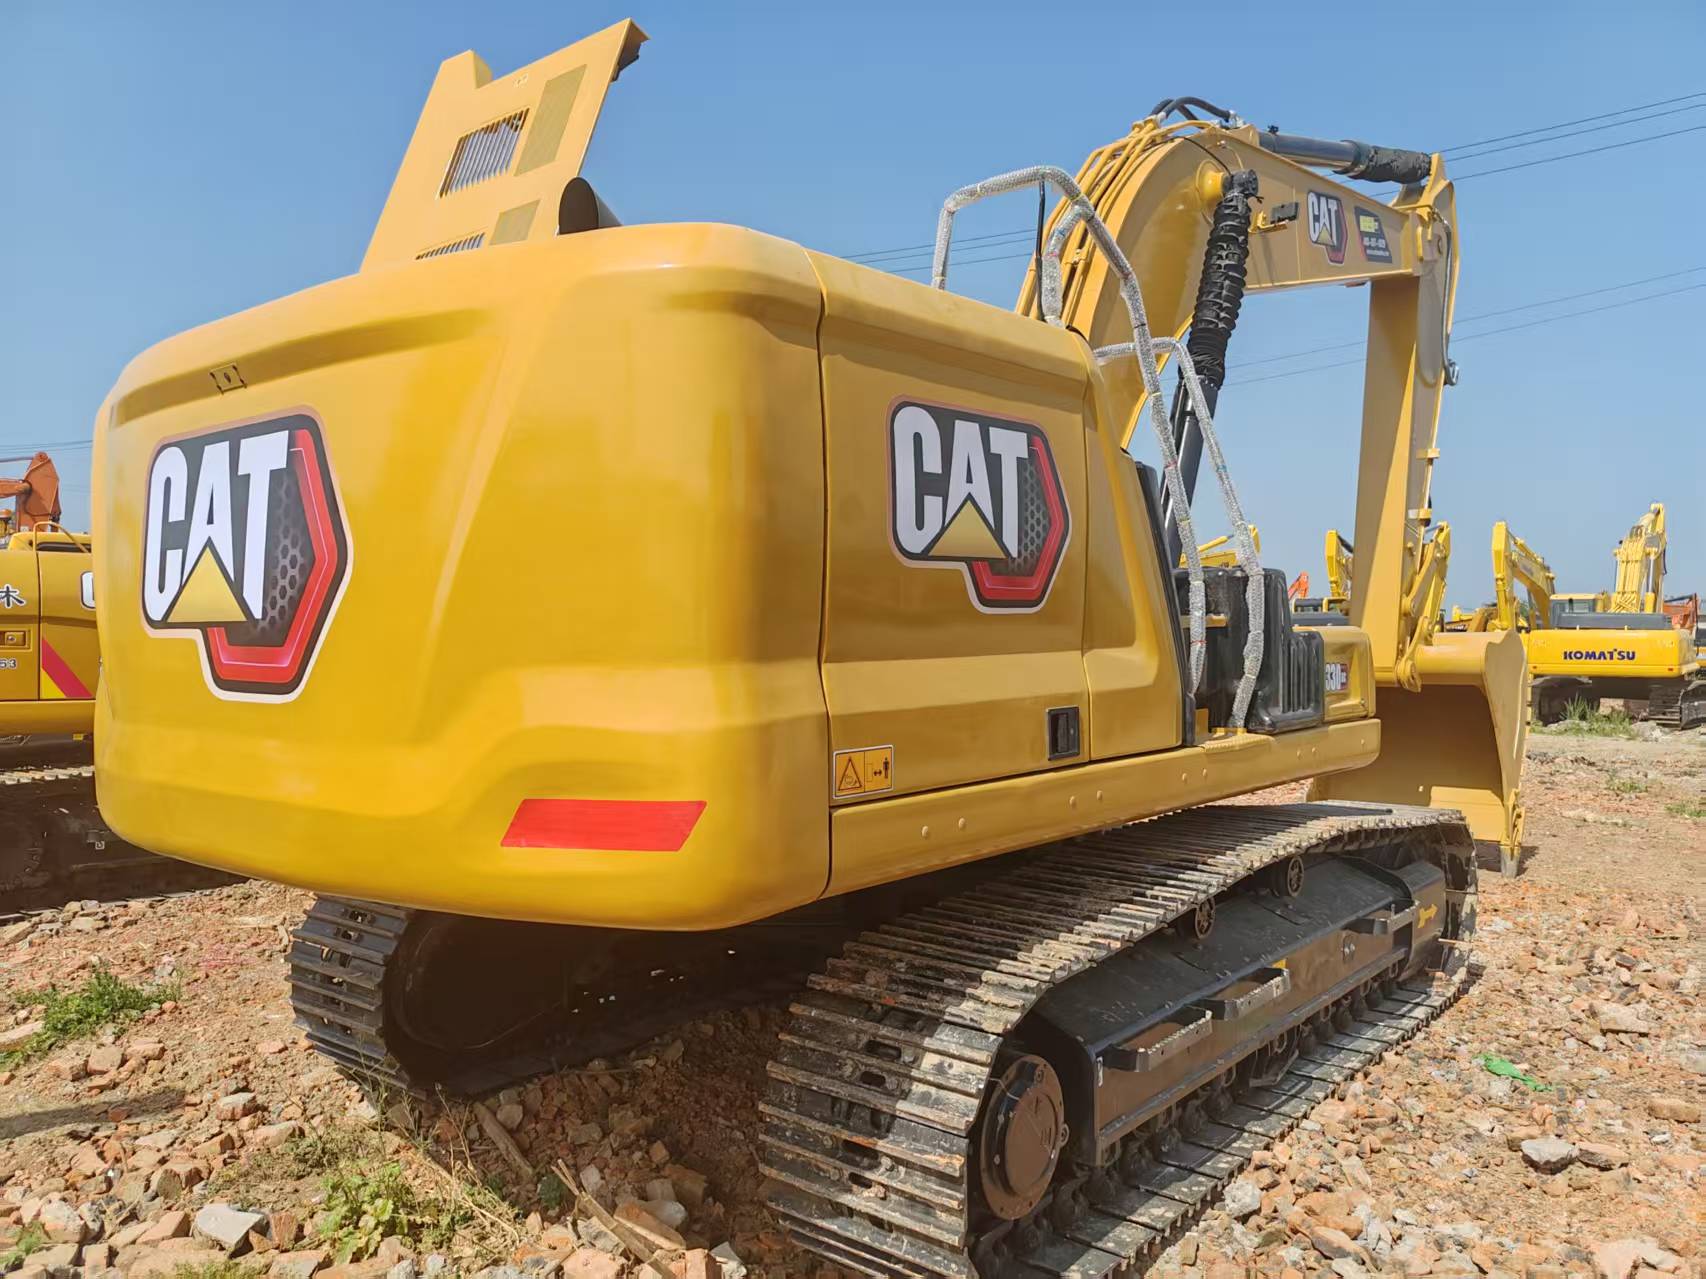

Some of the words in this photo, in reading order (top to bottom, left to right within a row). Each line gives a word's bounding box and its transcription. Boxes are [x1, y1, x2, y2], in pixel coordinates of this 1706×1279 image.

[1307, 191, 1338, 247] CAT
[143, 430, 289, 622] CAT
[893, 405, 1029, 559] CAT
[1563, 649, 1636, 661] KOMATSU
